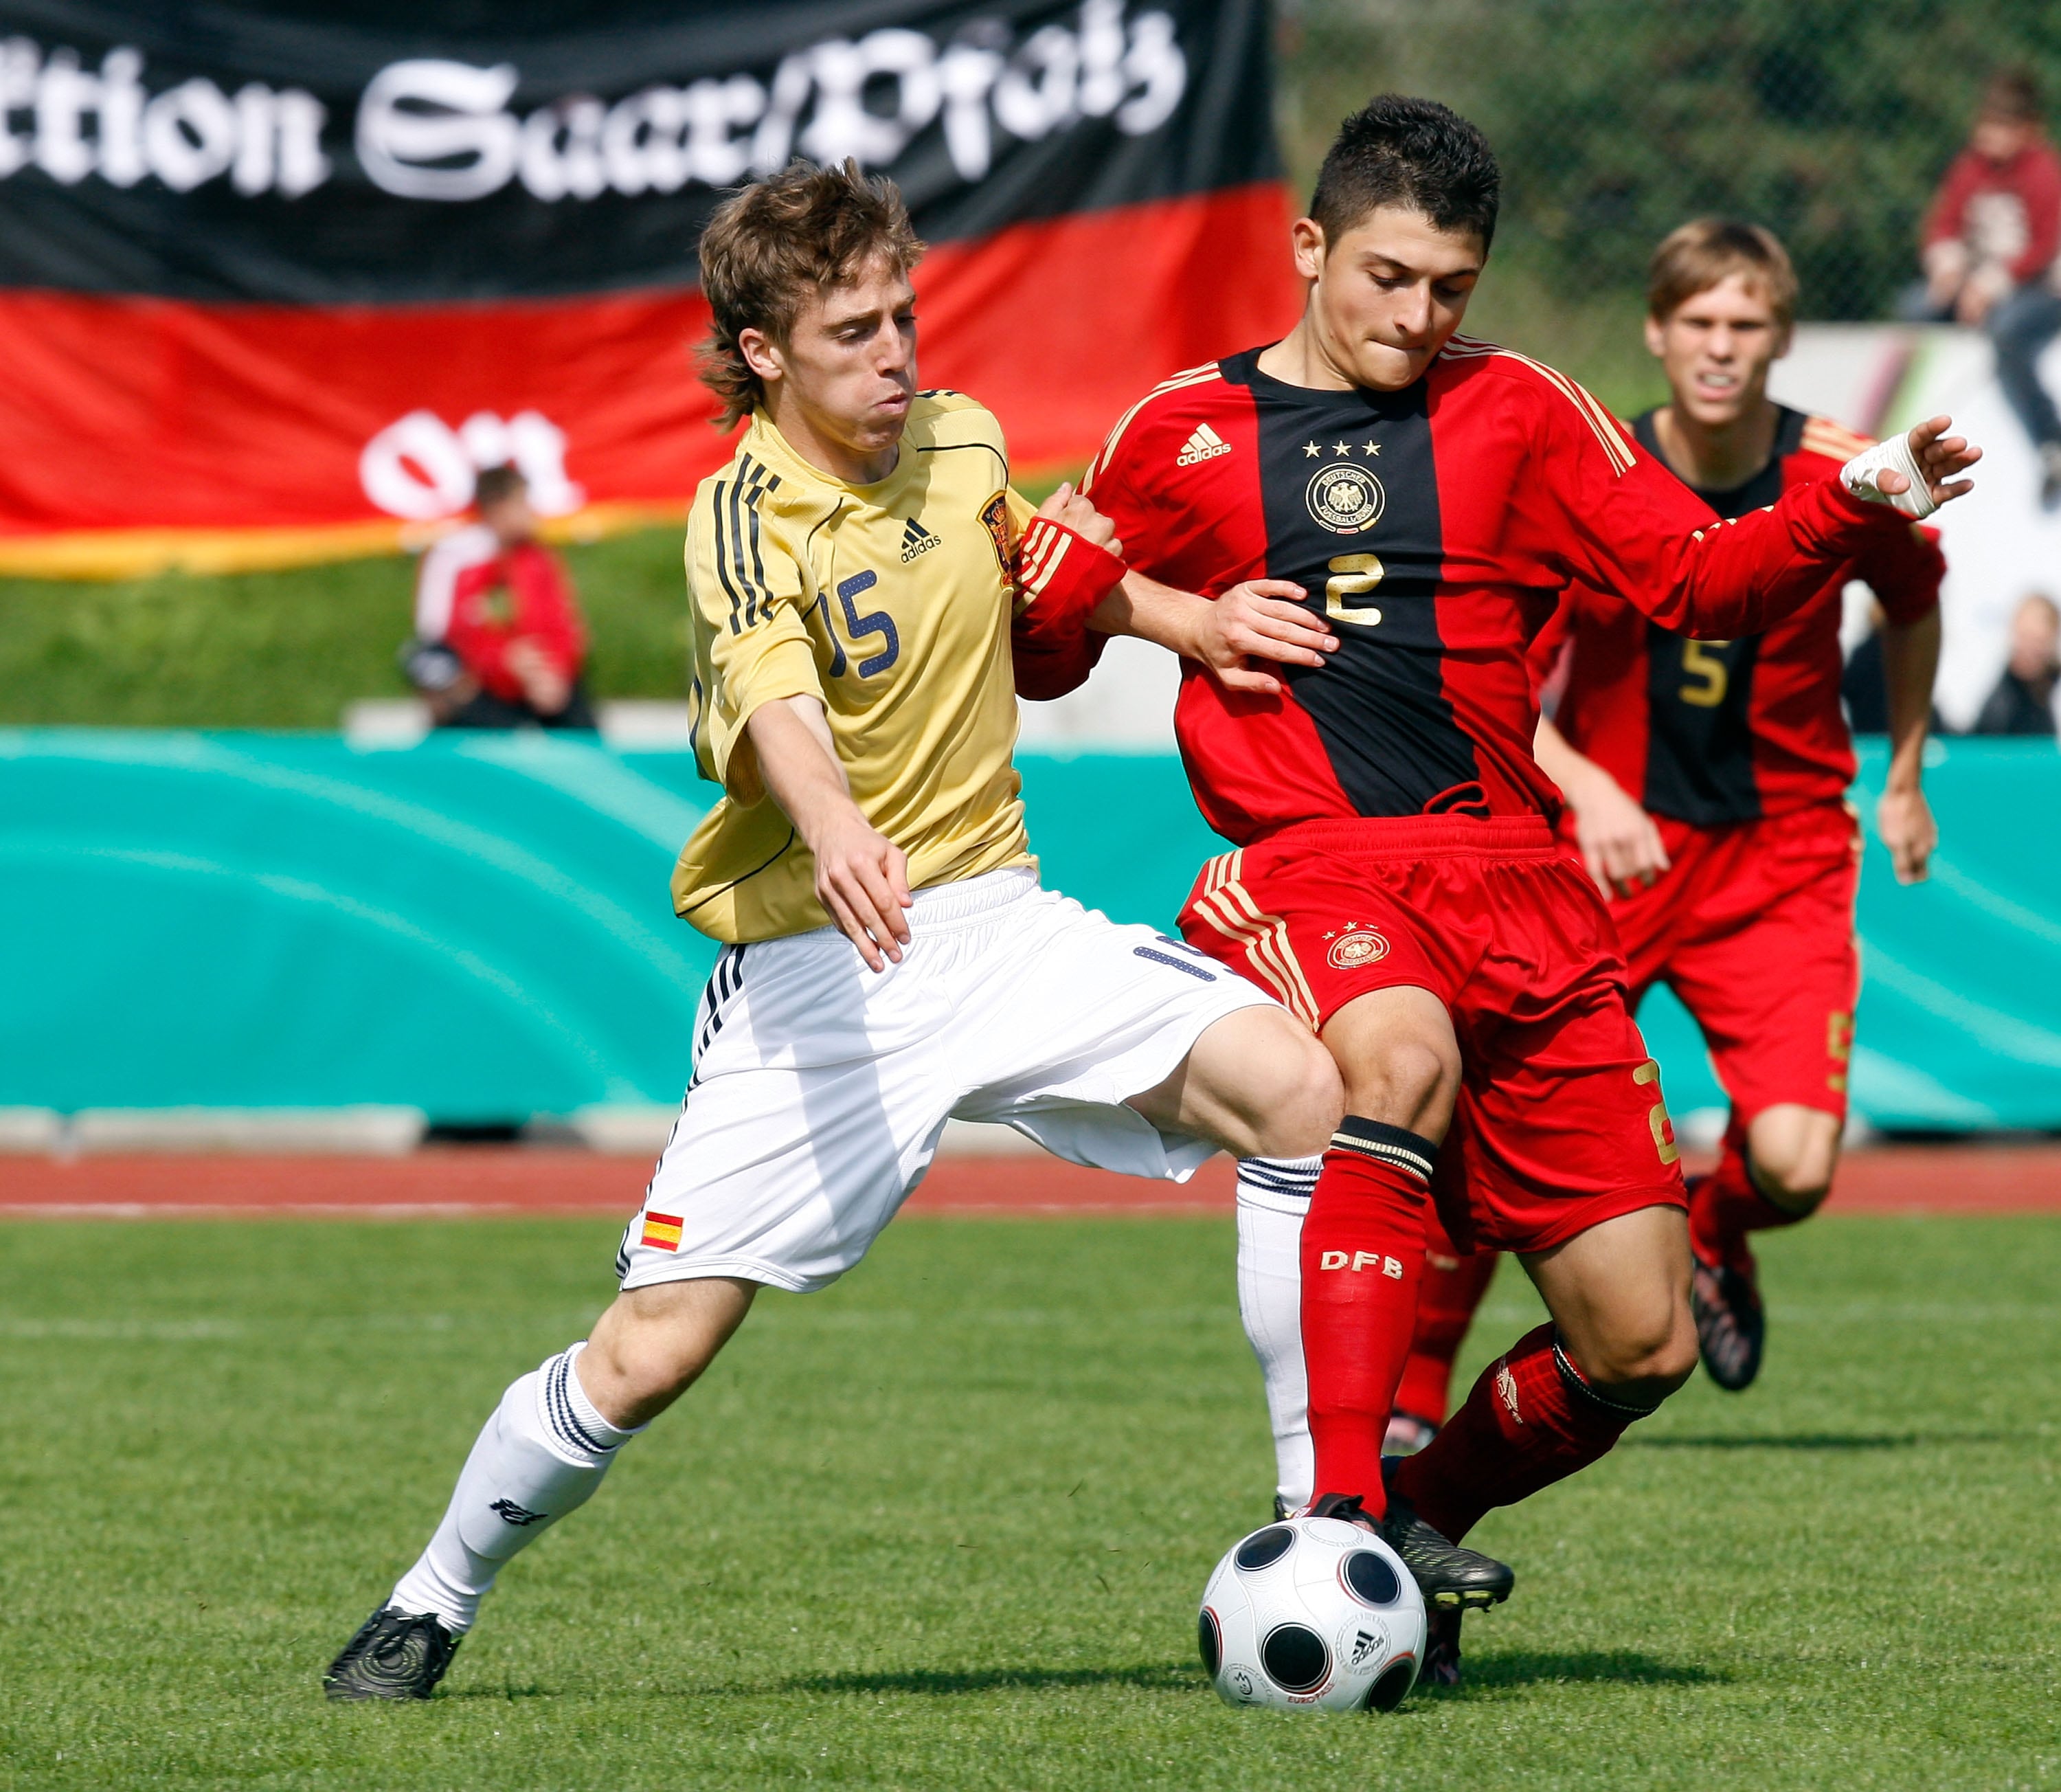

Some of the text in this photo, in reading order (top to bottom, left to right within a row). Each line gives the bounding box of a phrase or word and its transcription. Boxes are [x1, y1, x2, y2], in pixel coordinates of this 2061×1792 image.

[1176, 443, 1232, 467] adidas
[901, 535, 942, 563] adidas
[1326, 553, 1384, 626] 2
[818, 569, 899, 679] 15
[1680, 640, 1727, 707] 5
[1320, 1250, 1403, 1280] DFB
